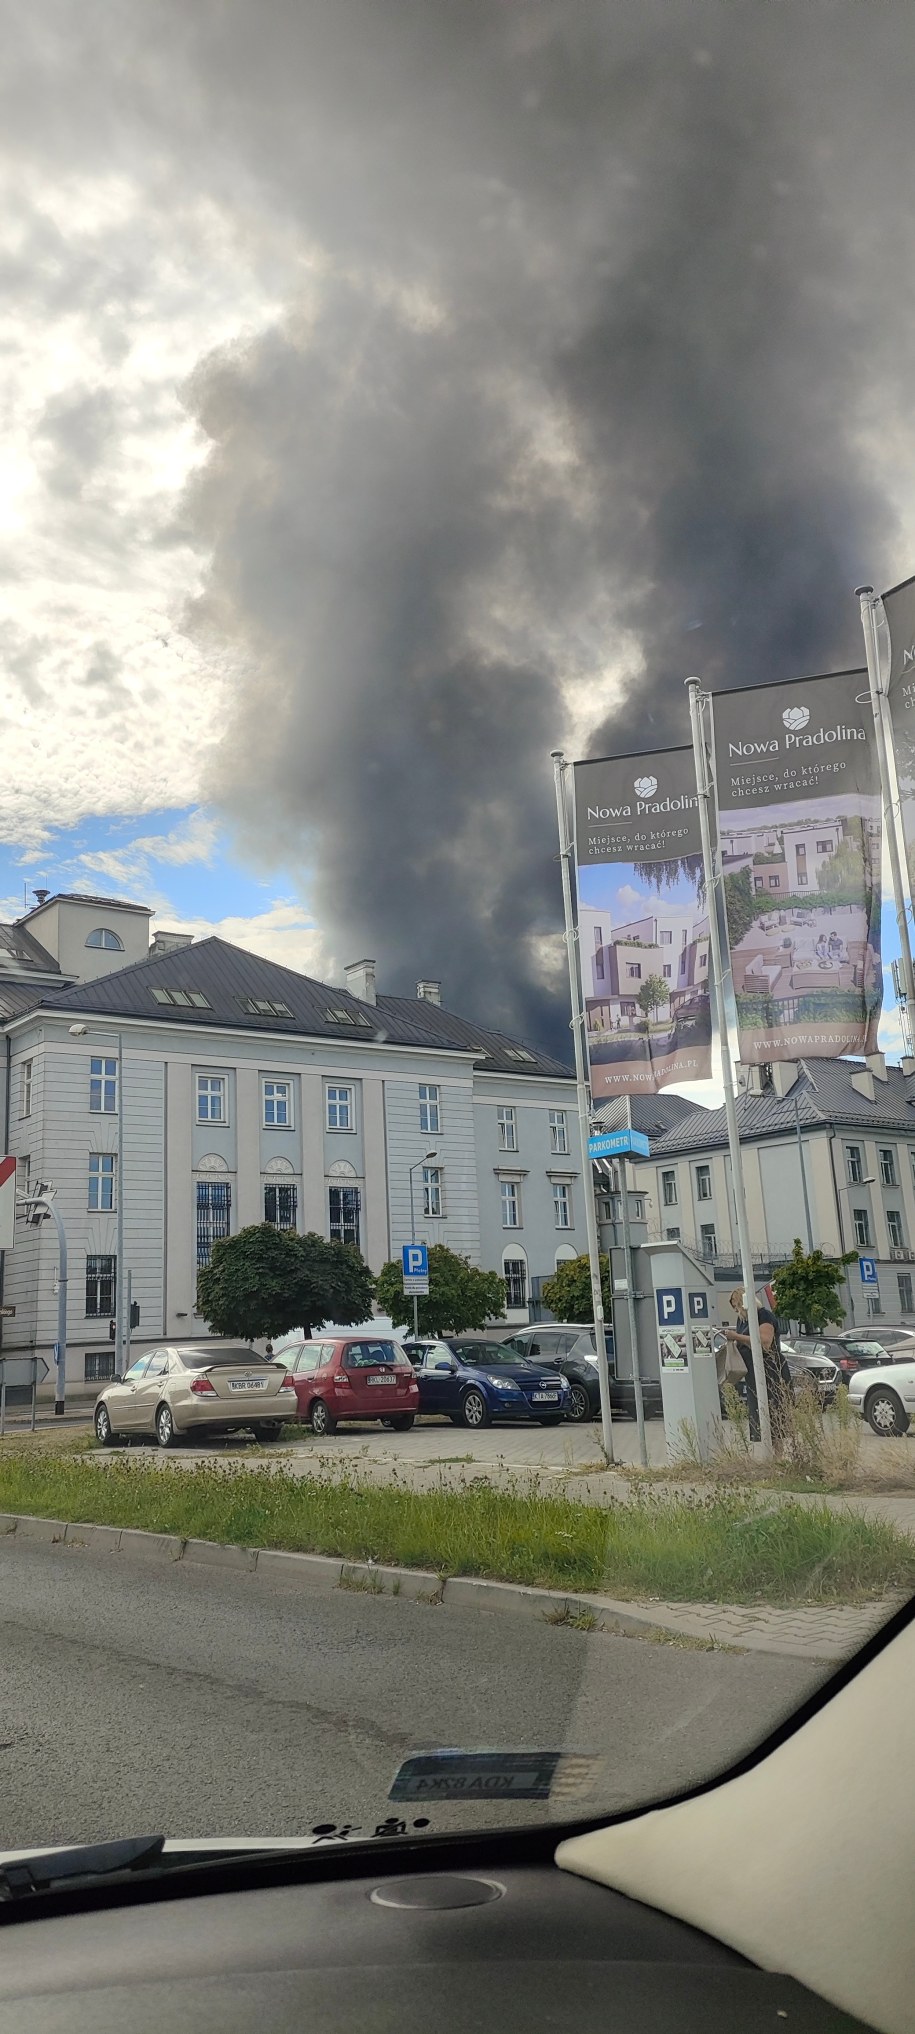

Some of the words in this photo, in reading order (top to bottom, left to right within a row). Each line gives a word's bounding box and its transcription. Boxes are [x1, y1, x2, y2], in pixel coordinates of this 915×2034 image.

[728, 740, 779, 758] Nowa
[785, 725, 867, 749] Pradolina
[730, 772, 779, 787] Miejsce,
[783, 768, 797, 779] do
[801, 761, 847, 776] którego
[731, 783, 770, 797] chcesz
[774, 776, 819, 791] wracać!
[587, 805, 631, 820] Nowa
[636, 795, 699, 815] Pradolin
[587, 835, 631, 846] Miejsce,
[634, 832, 647, 842] do
[650, 827, 689, 841] którego
[588, 844, 623, 855] chcesz
[626, 840, 666, 852] wracać!
[604, 1059, 699, 1084] WWW.NOWADOLINA.PL
[588, 1136, 629, 1154] PARKOMETR
[408, 1249, 423, 1273] P
[862, 1261, 873, 1281] P
[662, 1295, 677, 1320] P
[693, 1296, 704, 1314] P
